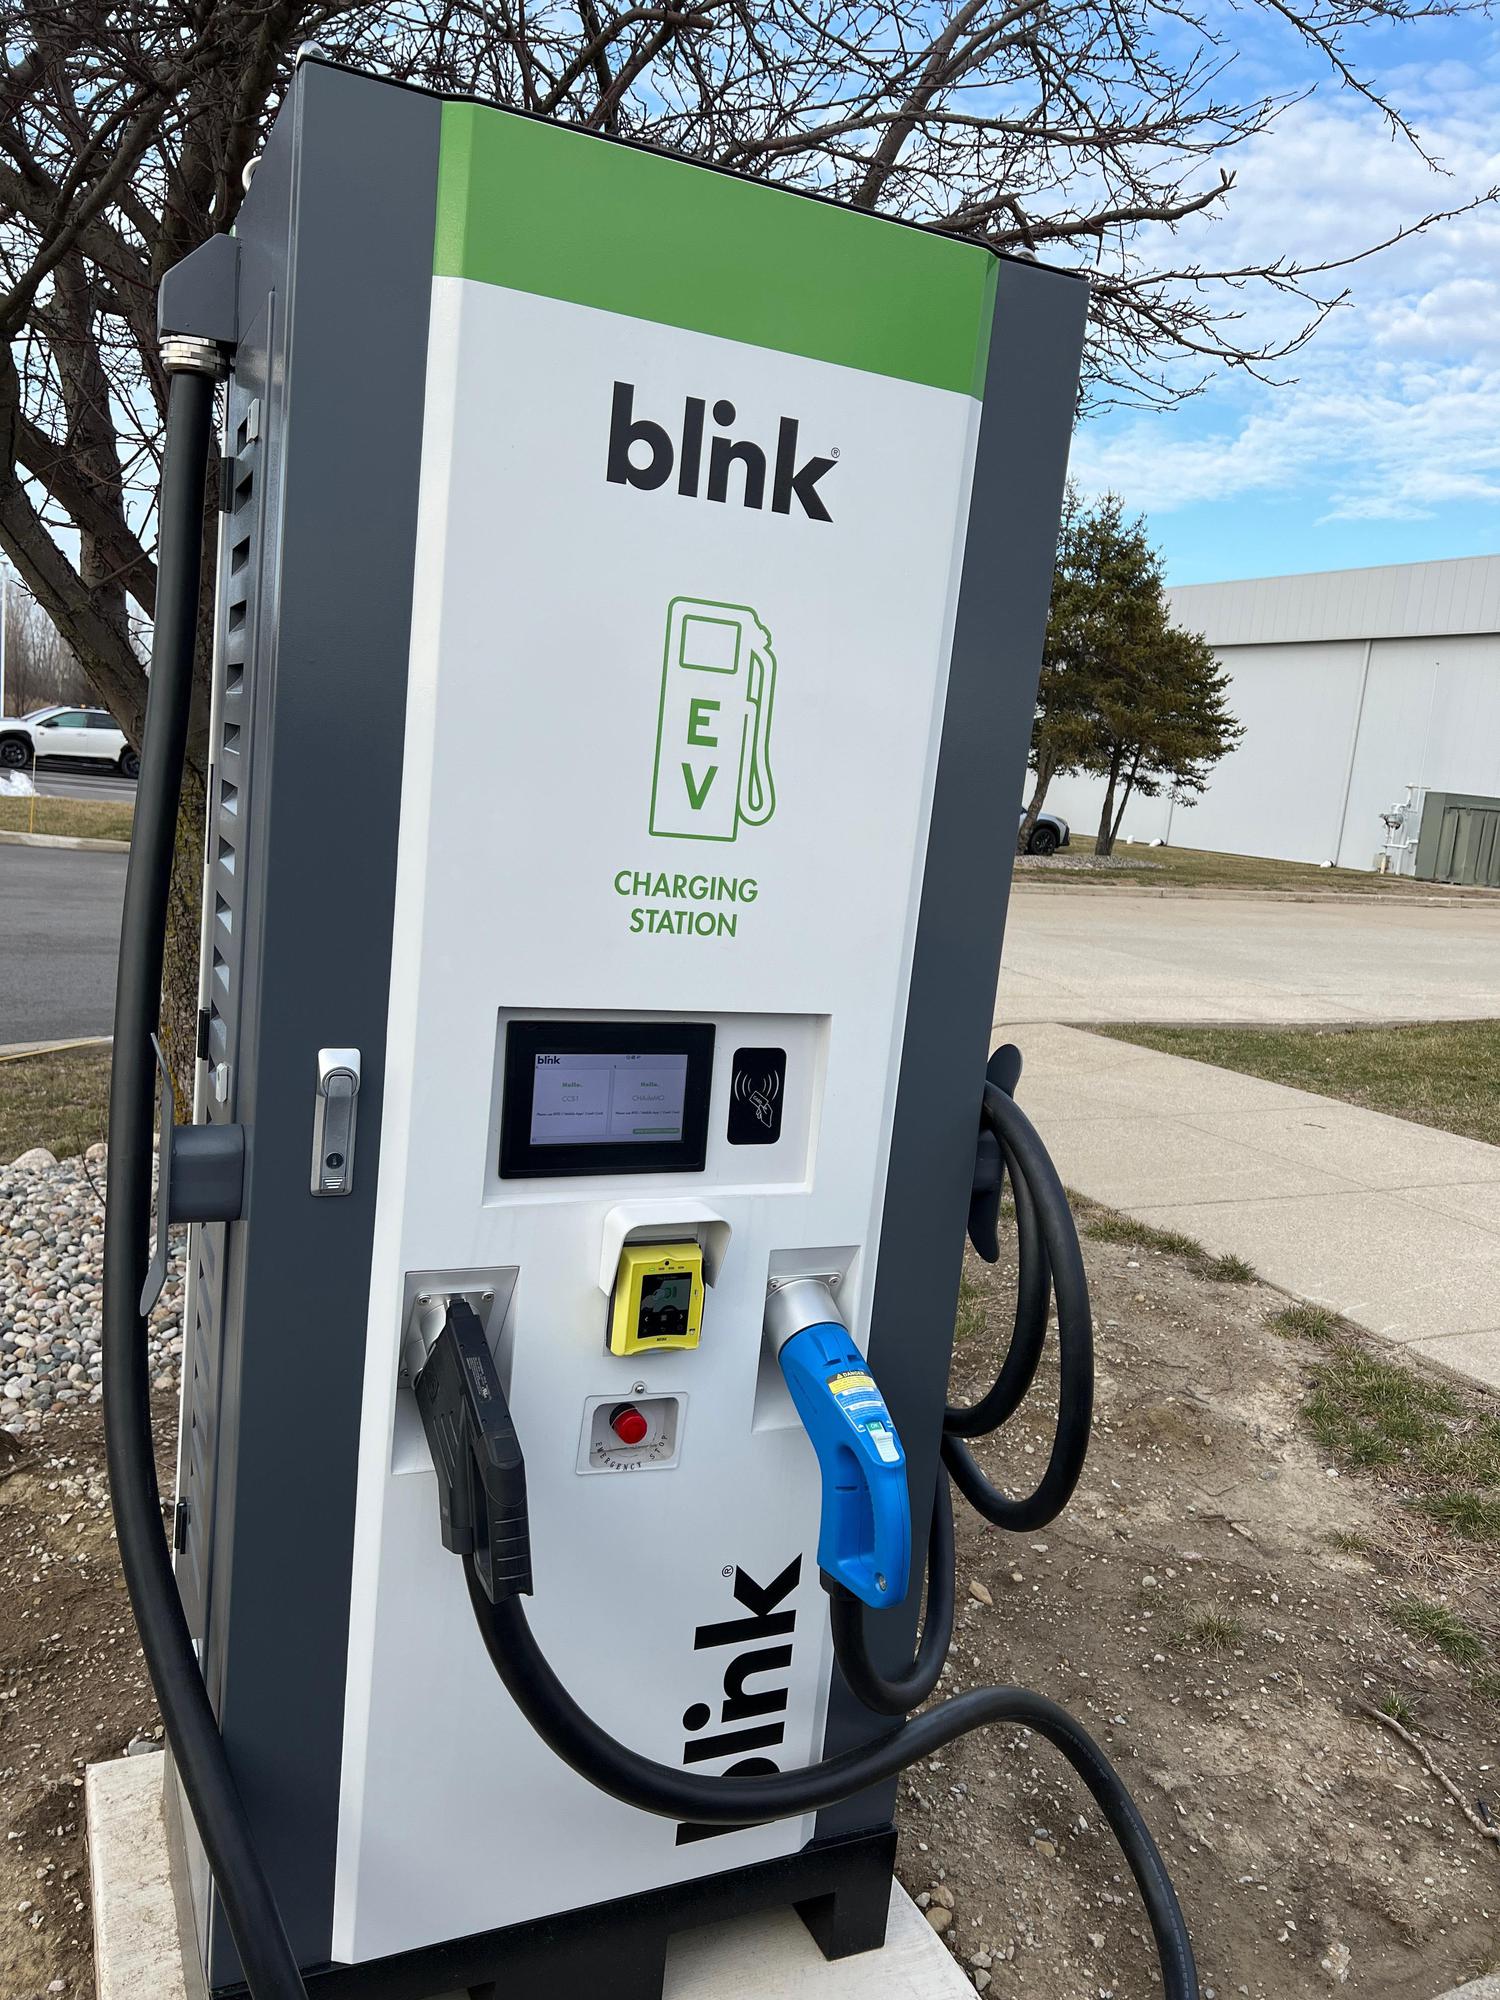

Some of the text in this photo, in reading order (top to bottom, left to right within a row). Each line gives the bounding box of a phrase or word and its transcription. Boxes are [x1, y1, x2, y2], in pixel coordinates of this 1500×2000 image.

[614, 870, 759, 903] CHARGING
[629, 908, 738, 938] STATION
[537, 1056, 561, 1065] blink
[596, 1435, 668, 1471] EMERGENCY STOP
